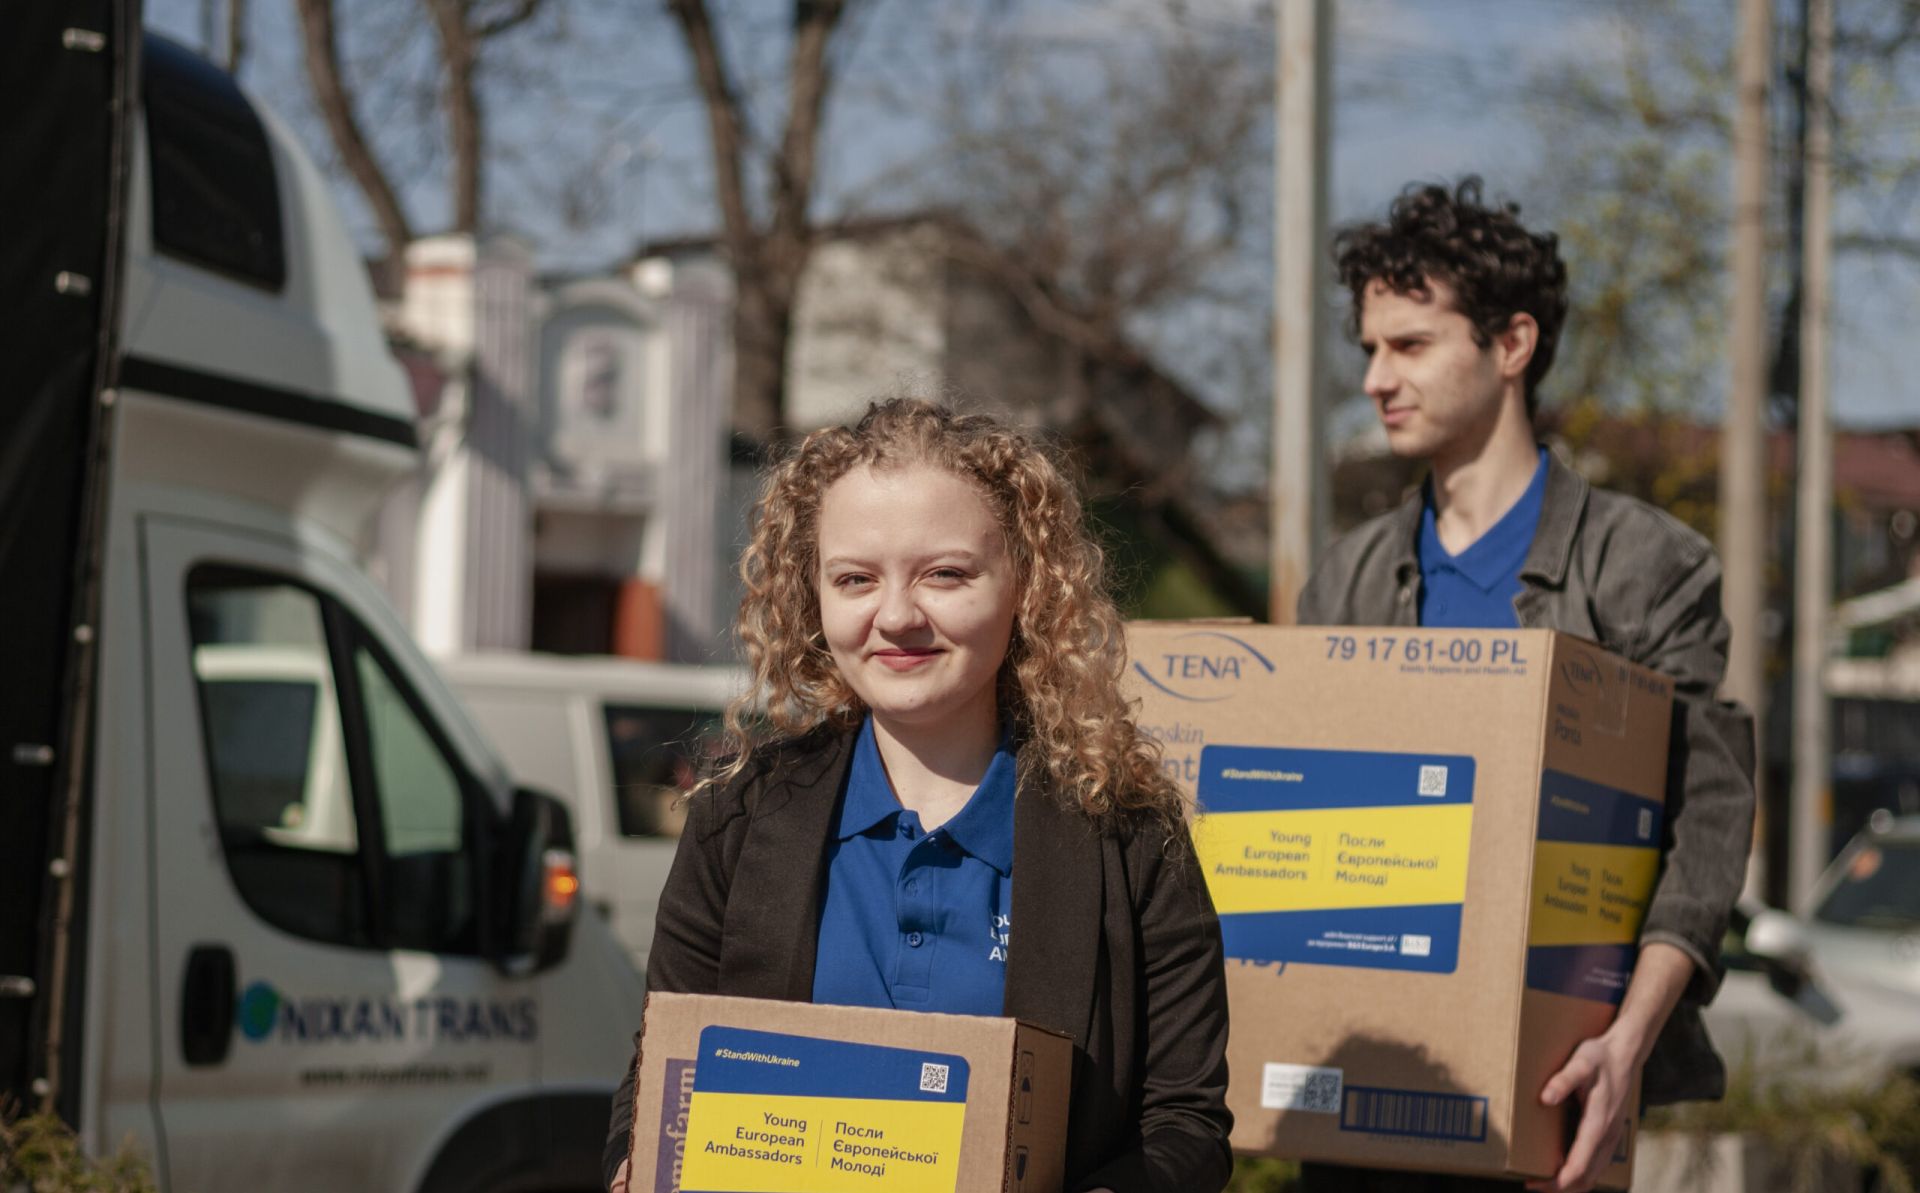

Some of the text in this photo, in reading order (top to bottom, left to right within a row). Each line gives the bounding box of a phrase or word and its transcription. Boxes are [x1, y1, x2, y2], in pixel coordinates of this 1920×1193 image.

[1326, 636, 1528, 665] 79 17 61-00 PL
[1162, 653, 1242, 680] TENA
[1270, 830, 1312, 847] Young
[1338, 833, 1386, 849] Посли
[1244, 846, 1311, 863] European
[1337, 852, 1440, 870] Європейської
[1214, 863, 1308, 881] Ambassadors
[1335, 870, 1389, 887] Молоді
[714, 1047, 801, 1068] #StandWithUkraine
[763, 1111, 808, 1133] Young
[834, 1121, 884, 1140] Посли
[735, 1126, 806, 1148] European
[704, 1141, 803, 1166] Ambassadors
[832, 1138, 940, 1166] Європейської
[830, 1155, 886, 1177] Молоді
